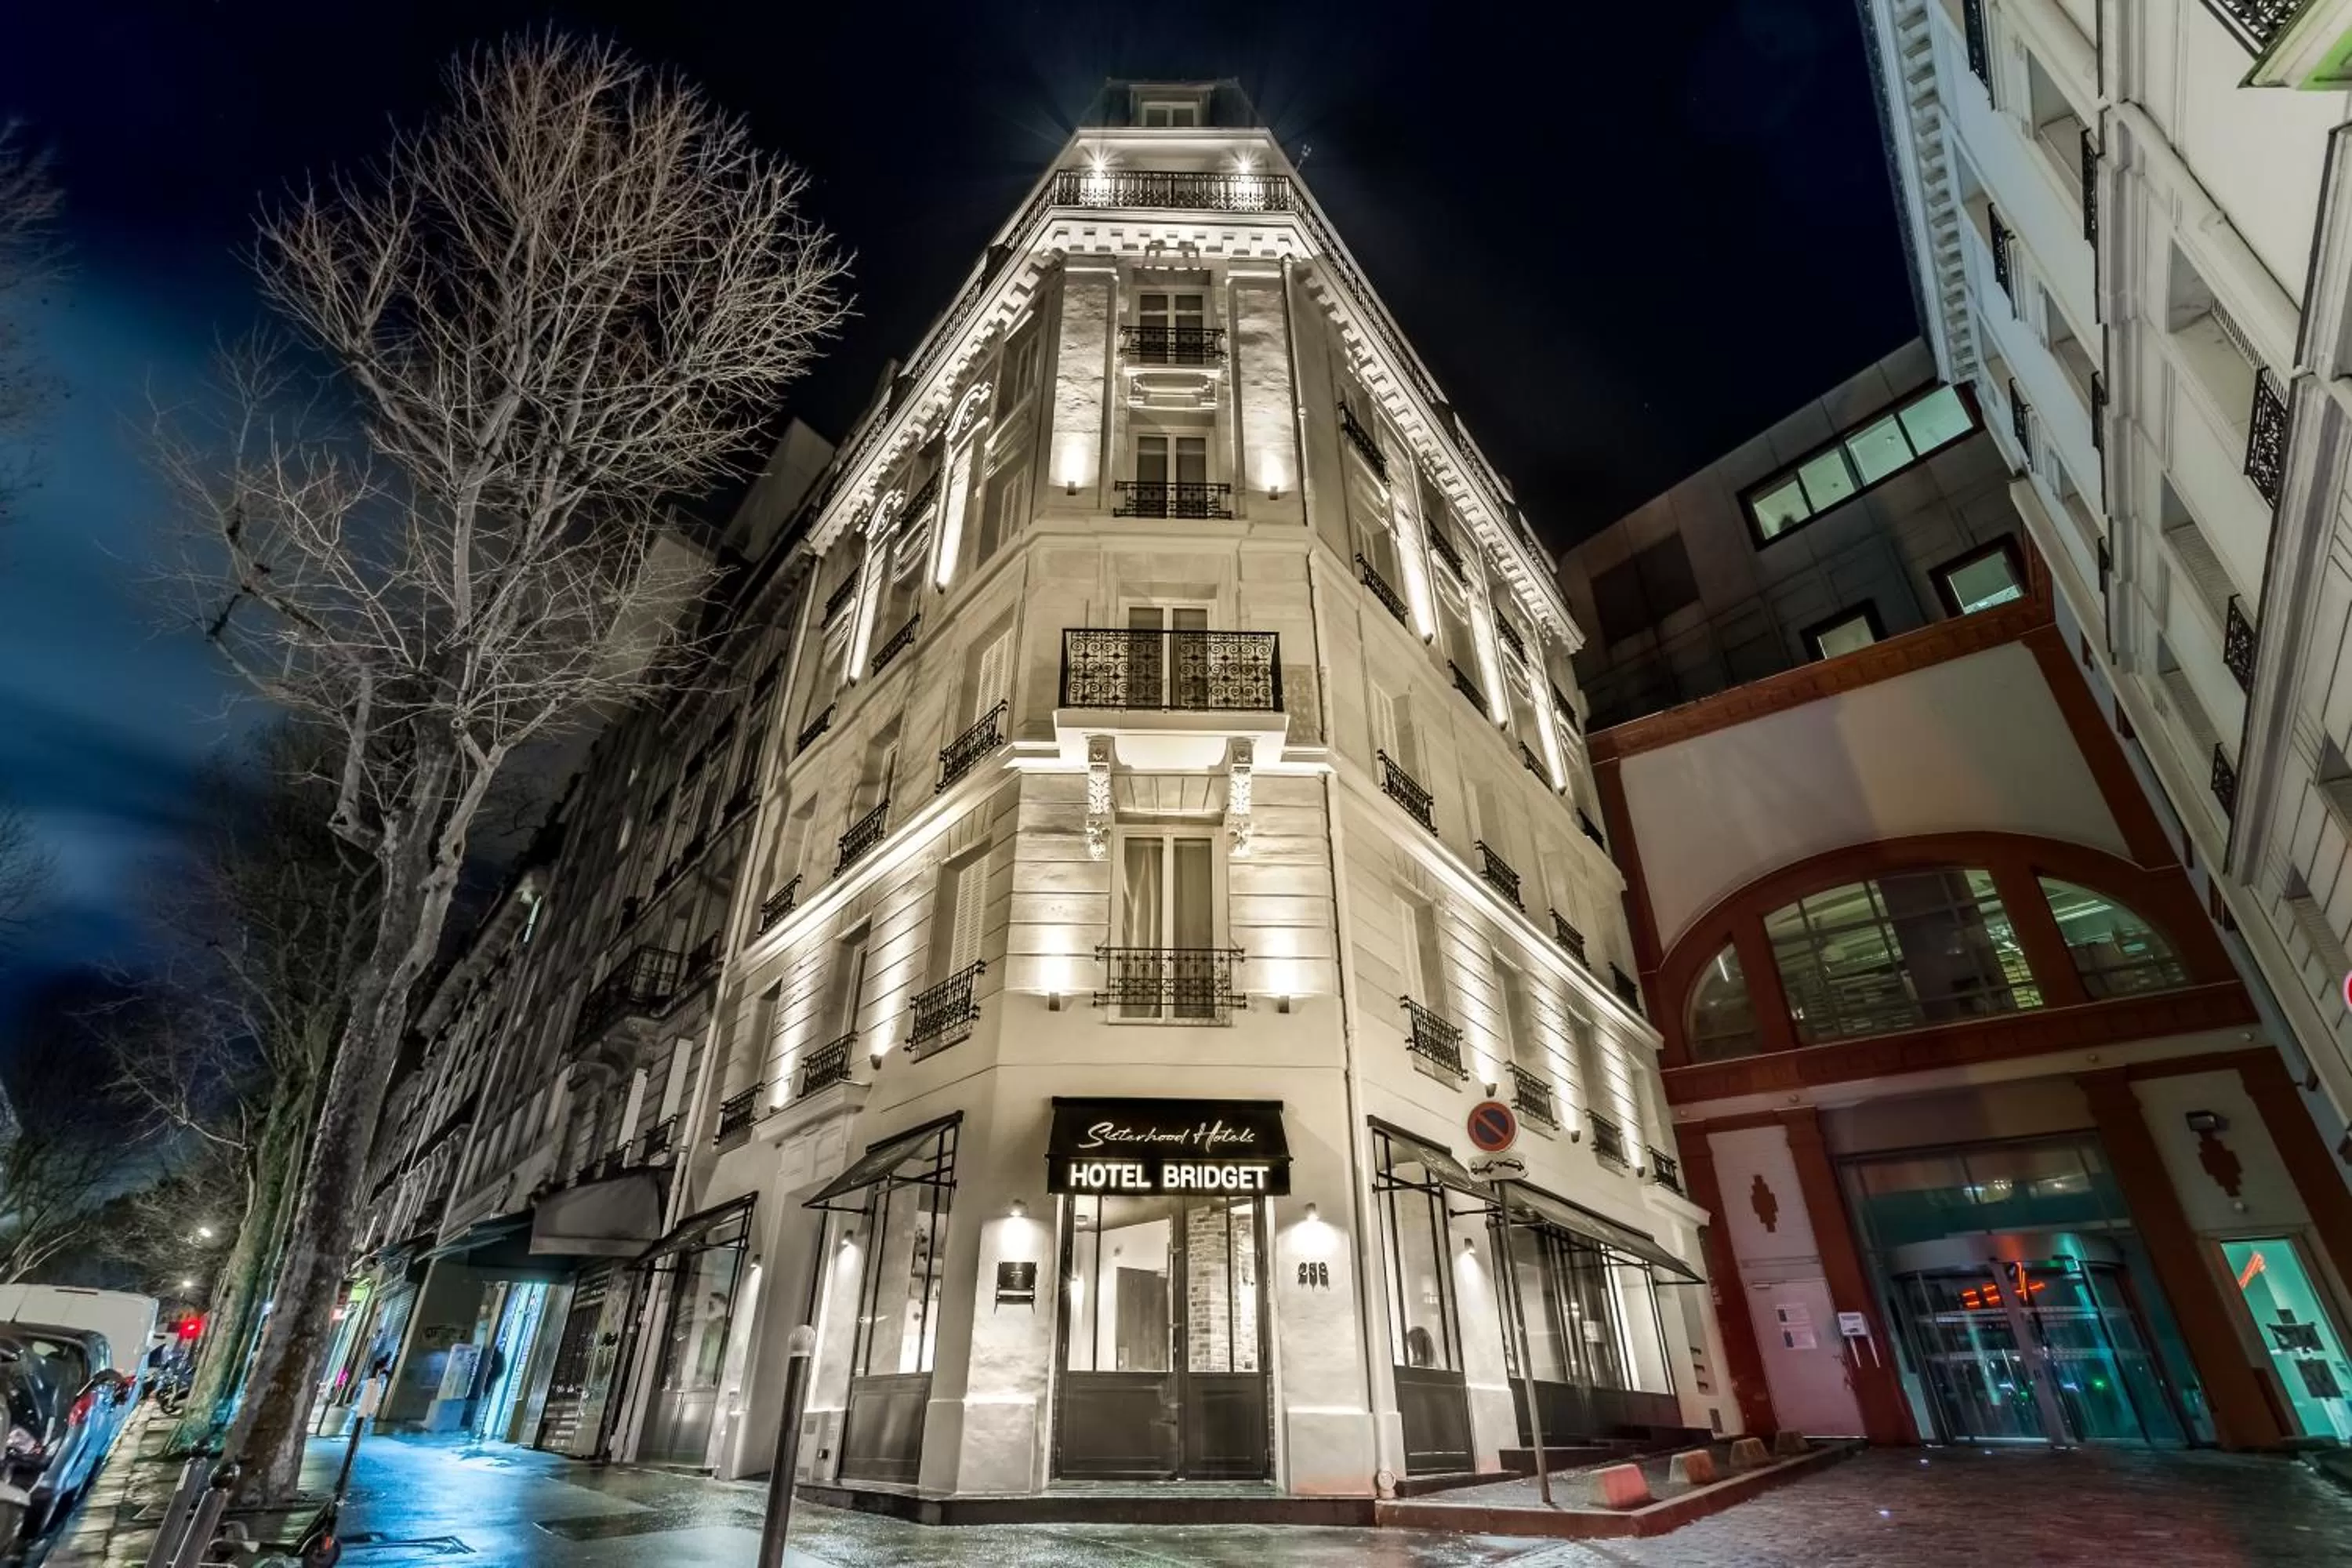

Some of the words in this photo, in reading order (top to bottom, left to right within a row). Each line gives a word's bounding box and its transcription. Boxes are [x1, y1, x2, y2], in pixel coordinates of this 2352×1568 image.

[1192, 1119, 1255, 1152] Hotels
[1069, 1163, 1152, 1189] HOTEL
[1162, 1163, 1270, 1189] BRIDGET
